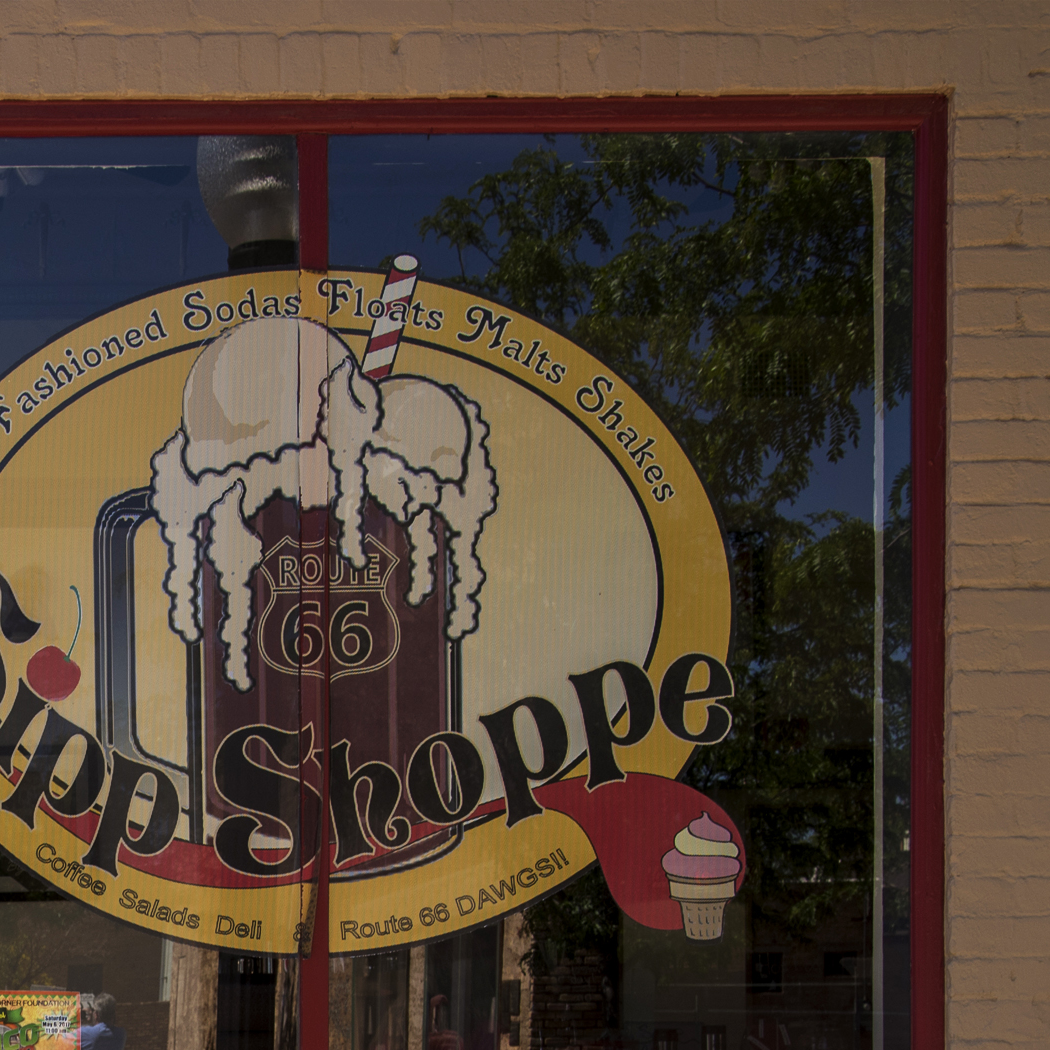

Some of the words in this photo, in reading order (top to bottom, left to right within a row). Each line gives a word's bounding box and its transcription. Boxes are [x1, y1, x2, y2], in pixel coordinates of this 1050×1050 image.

[182, 288, 301, 332] Sodas
[317, 277, 444, 331] Floats
[457, 304, 567, 385] Malts
[575, 374, 675, 503] Shakes
[280, 601, 374, 667] 66
[213, 652, 735, 878] Shoppe
[35, 842, 107, 896] Coffee
[118, 888, 201, 930] Salads
[215, 915, 263, 940] Deli
[340, 914, 414, 941] Route
[419, 902, 450, 928] 66
[456, 848, 570, 917] DAWGS!!
